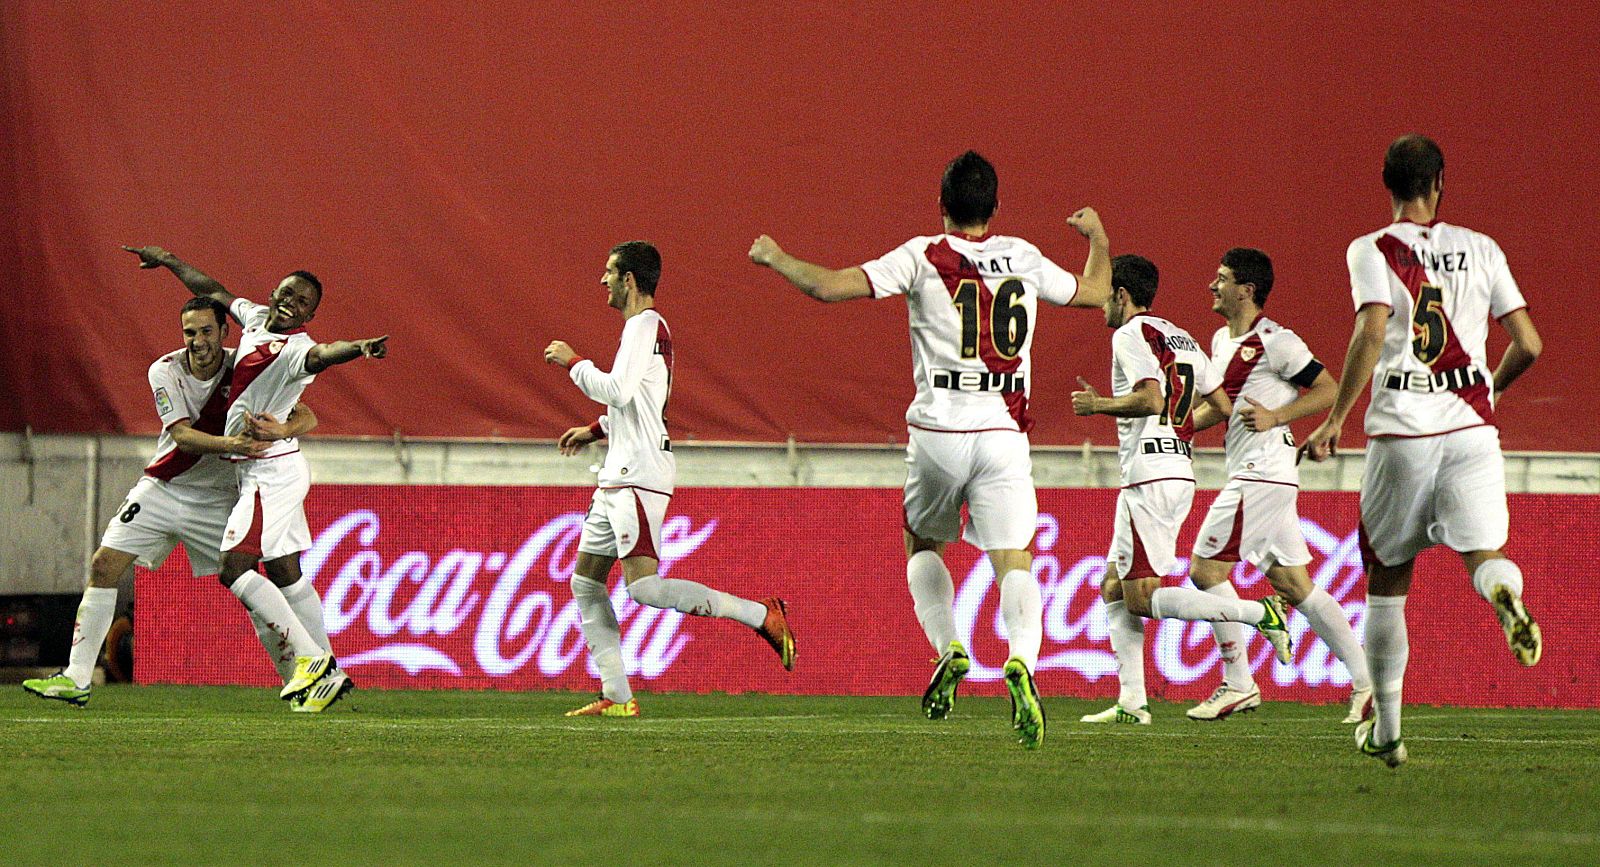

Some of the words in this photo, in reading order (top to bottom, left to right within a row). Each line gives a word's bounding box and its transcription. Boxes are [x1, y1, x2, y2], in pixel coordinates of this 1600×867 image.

[953, 278, 1029, 360] 16
[1412, 281, 1449, 367] 5
[1159, 362, 1196, 427] 17
